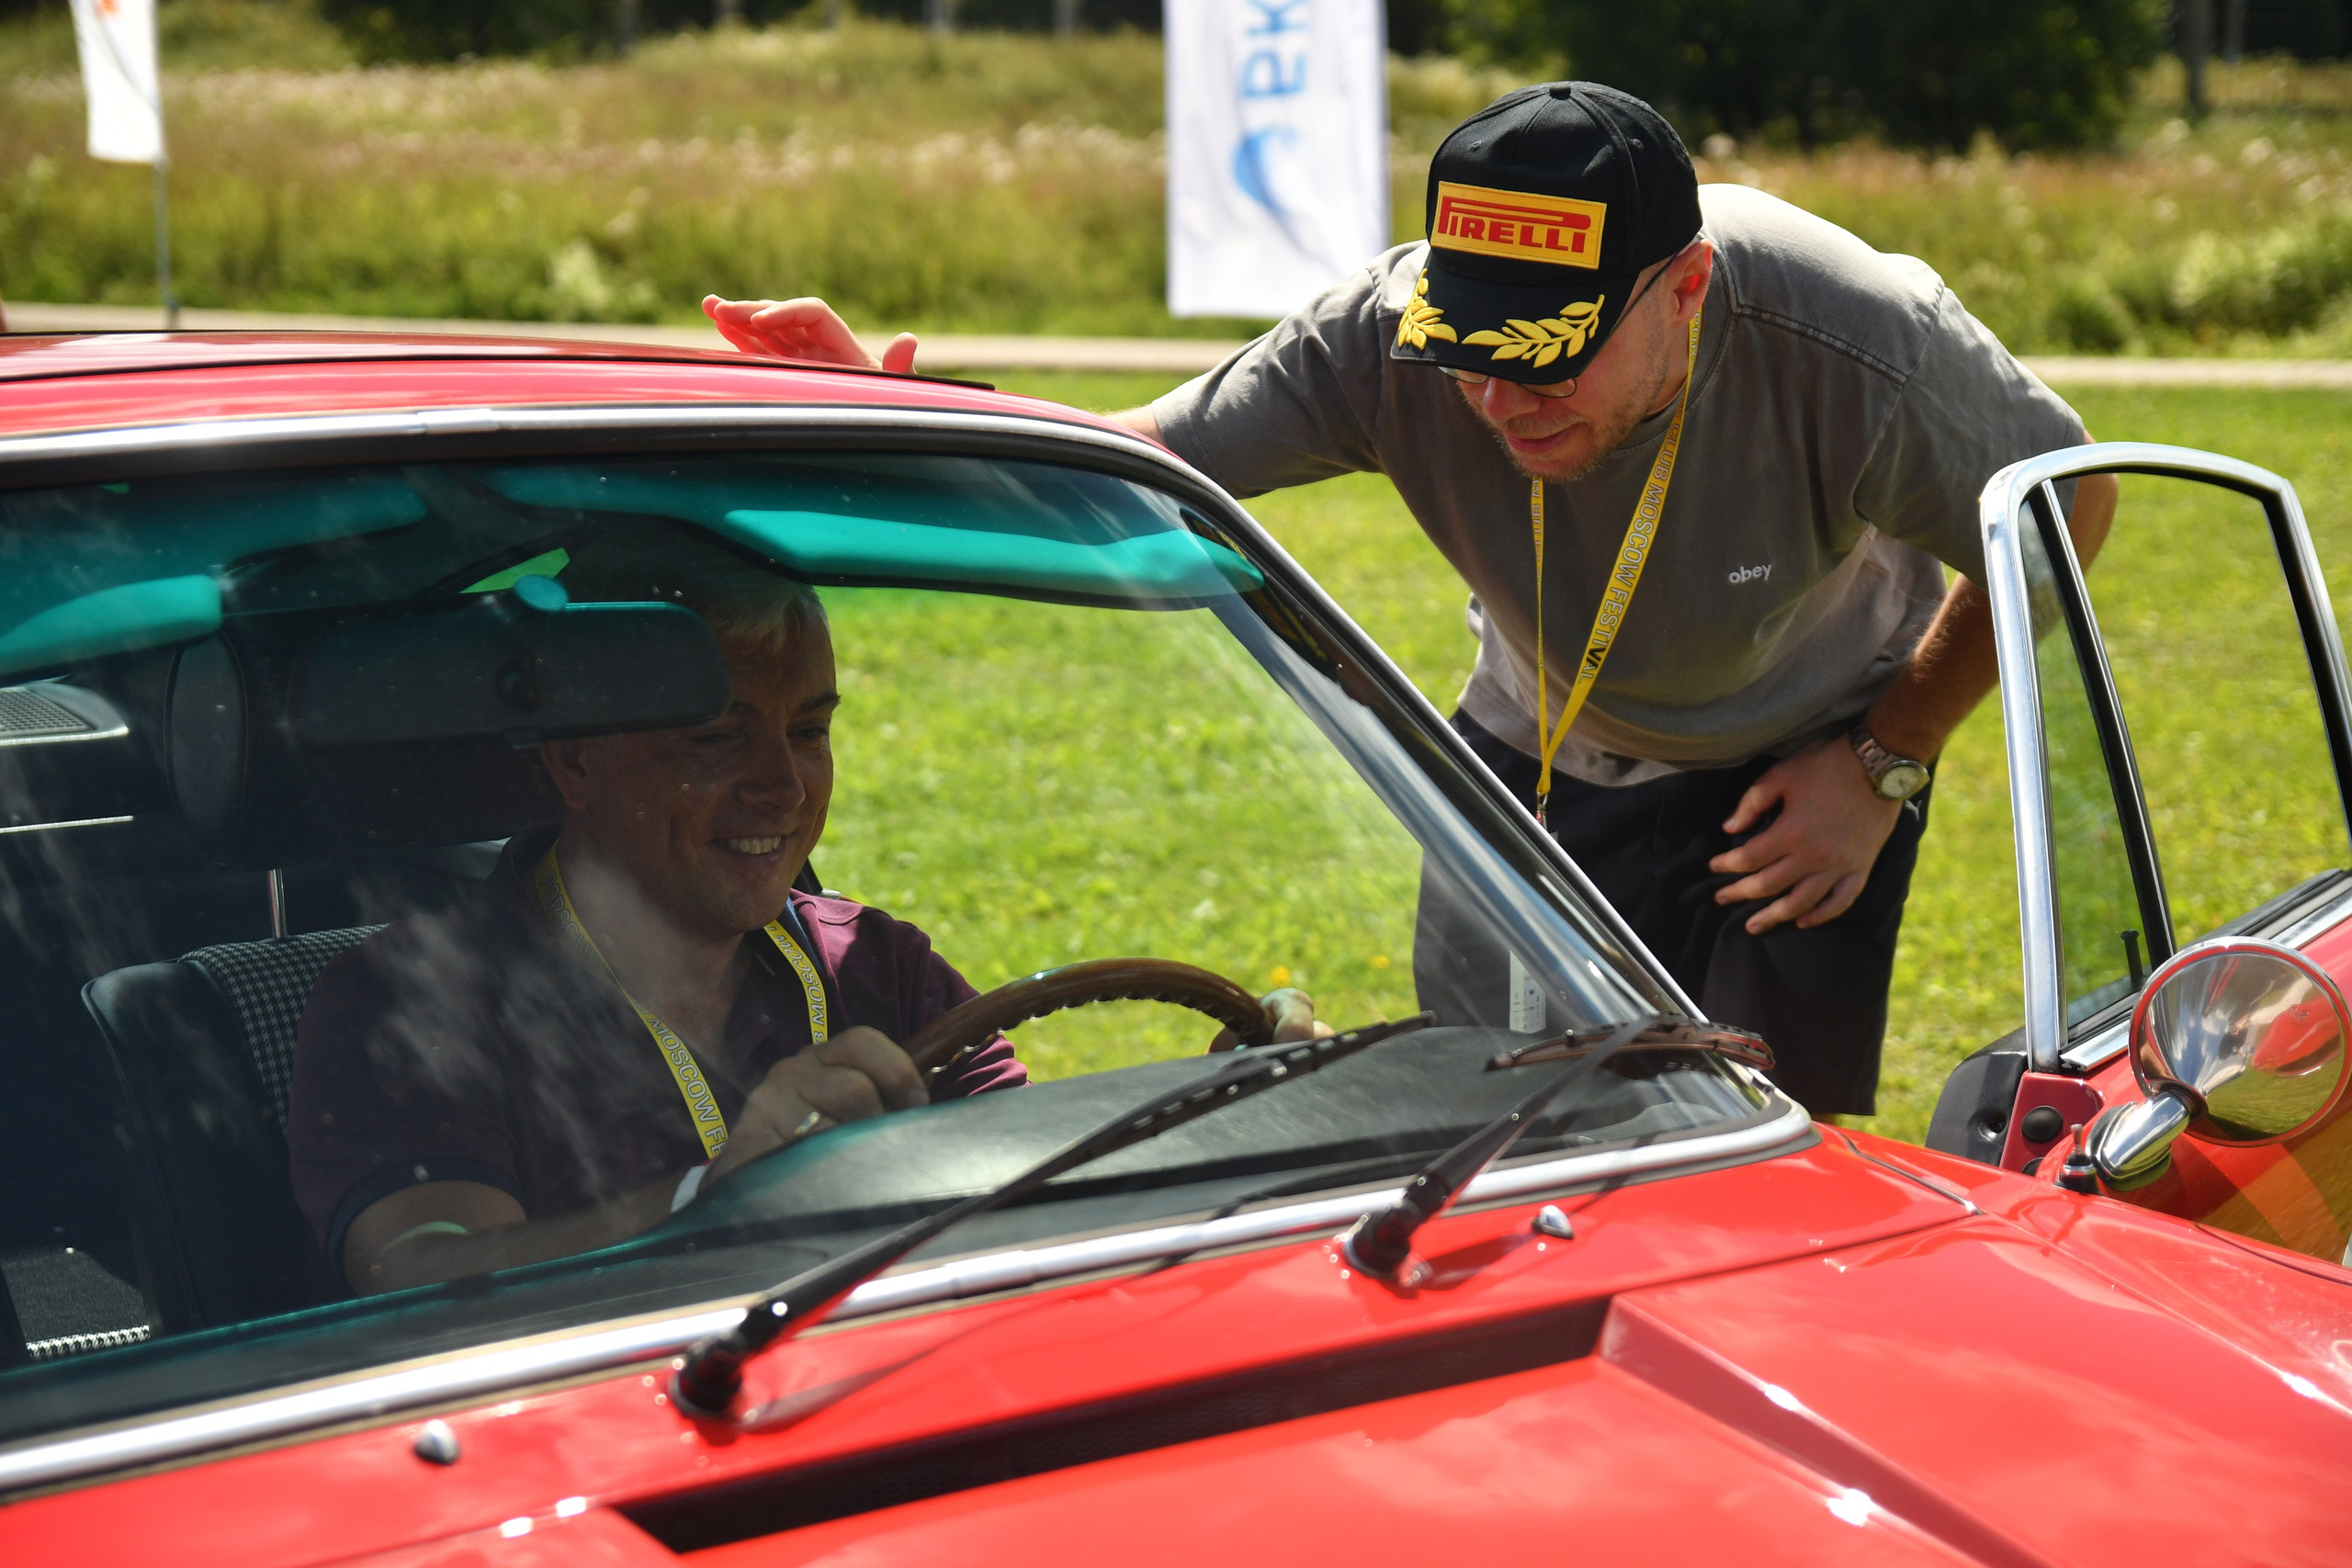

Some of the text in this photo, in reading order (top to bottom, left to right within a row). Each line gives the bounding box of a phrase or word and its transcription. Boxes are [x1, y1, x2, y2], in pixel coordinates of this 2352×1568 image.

[1437, 196, 1591, 254] PIRELLI
[1577, 423, 1681, 683] CLUB MOSCOW FESTIVAL
[1728, 563, 1772, 584] obey
[775, 935, 825, 1026] MOSCOW
[648, 1018, 720, 1122] MOSCOW
